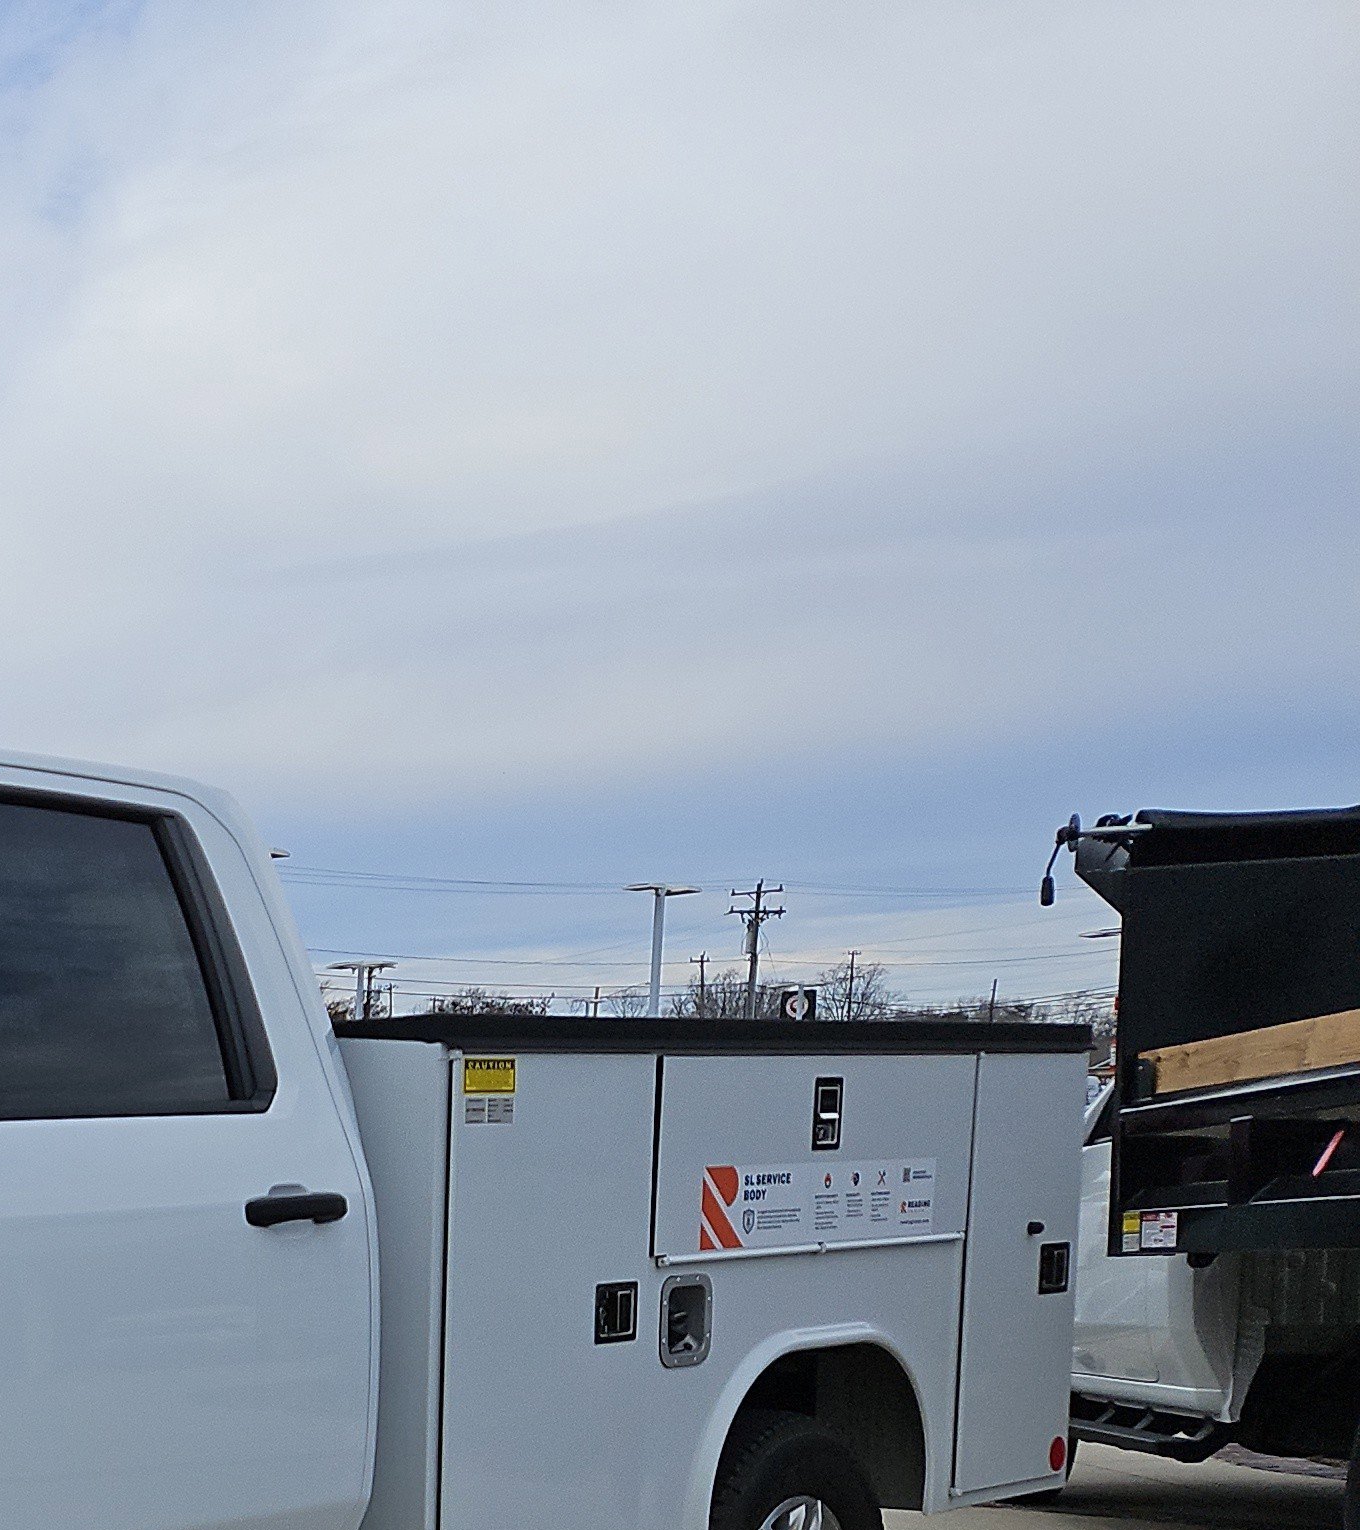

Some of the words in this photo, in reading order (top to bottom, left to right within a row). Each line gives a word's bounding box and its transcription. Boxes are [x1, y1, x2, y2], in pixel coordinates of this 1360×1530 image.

[468, 1061, 513, 1069] CAUTION
[744, 1175, 755, 1186] SL
[756, 1173, 792, 1185] SERVICE
[743, 1189, 767, 1201] BODY
